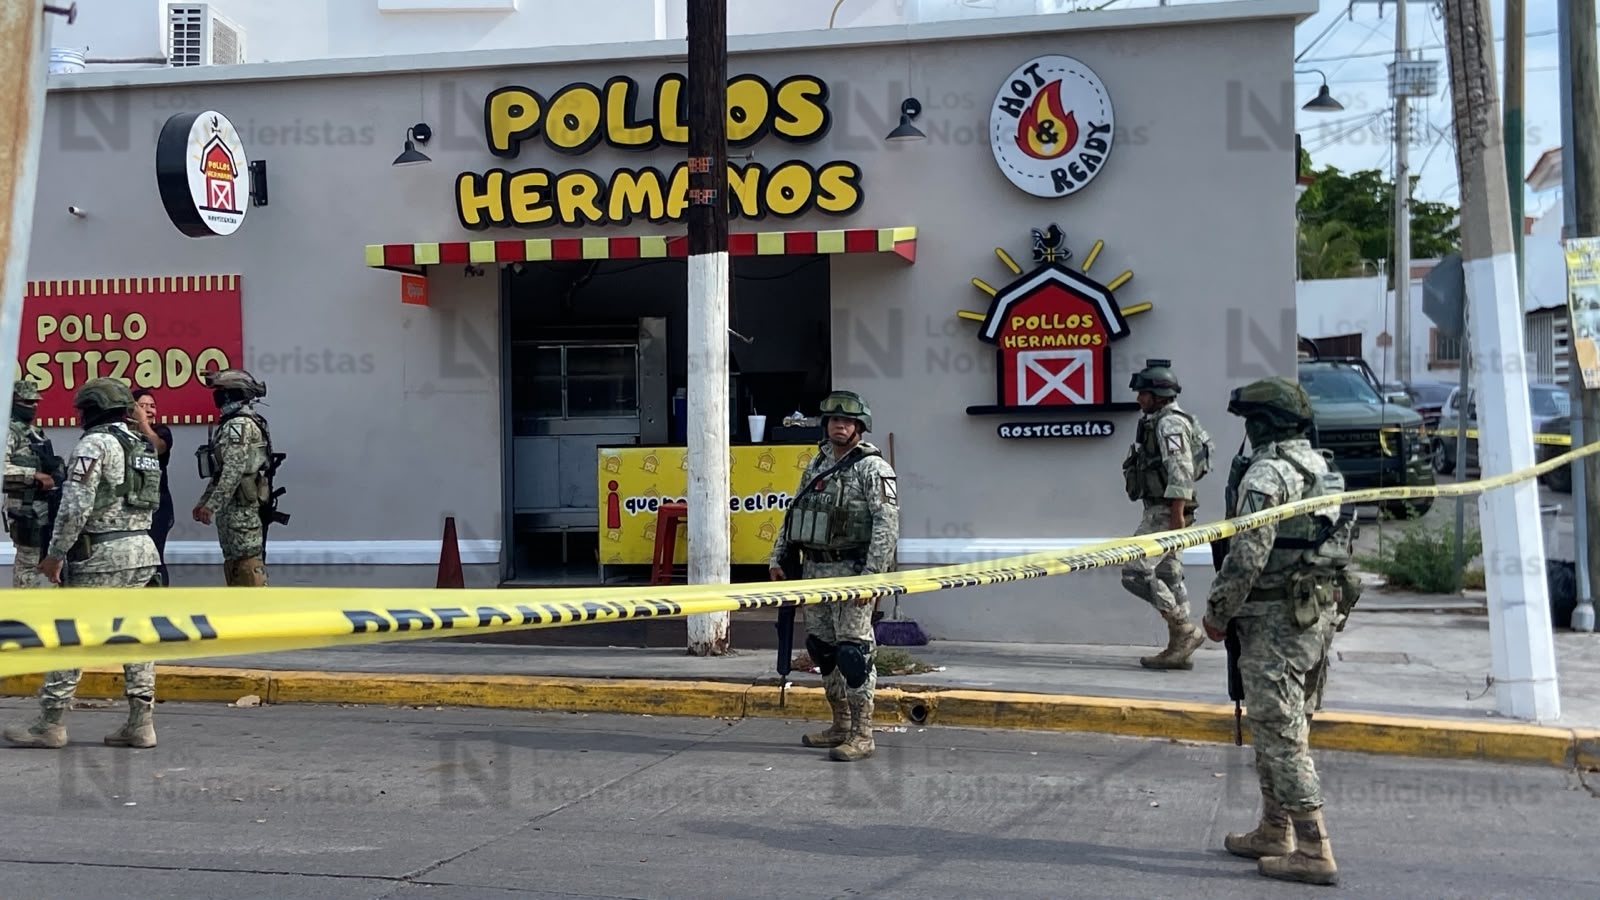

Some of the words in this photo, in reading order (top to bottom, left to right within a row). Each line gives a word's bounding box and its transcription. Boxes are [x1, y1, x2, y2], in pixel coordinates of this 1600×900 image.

[998, 63, 1046, 119] HOT
[486, 74, 829, 156] POLLOS
[1036, 119, 1059, 144] &
[1050, 121, 1111, 193] READY
[36, 312, 148, 343] POLLO
[1011, 313, 1094, 331] POLLOS
[1004, 333, 1102, 348] HERMANOS
[1000, 421, 1112, 438] ROSTICERÍAS
[625, 497, 658, 514] que
[744, 494, 763, 511] el
